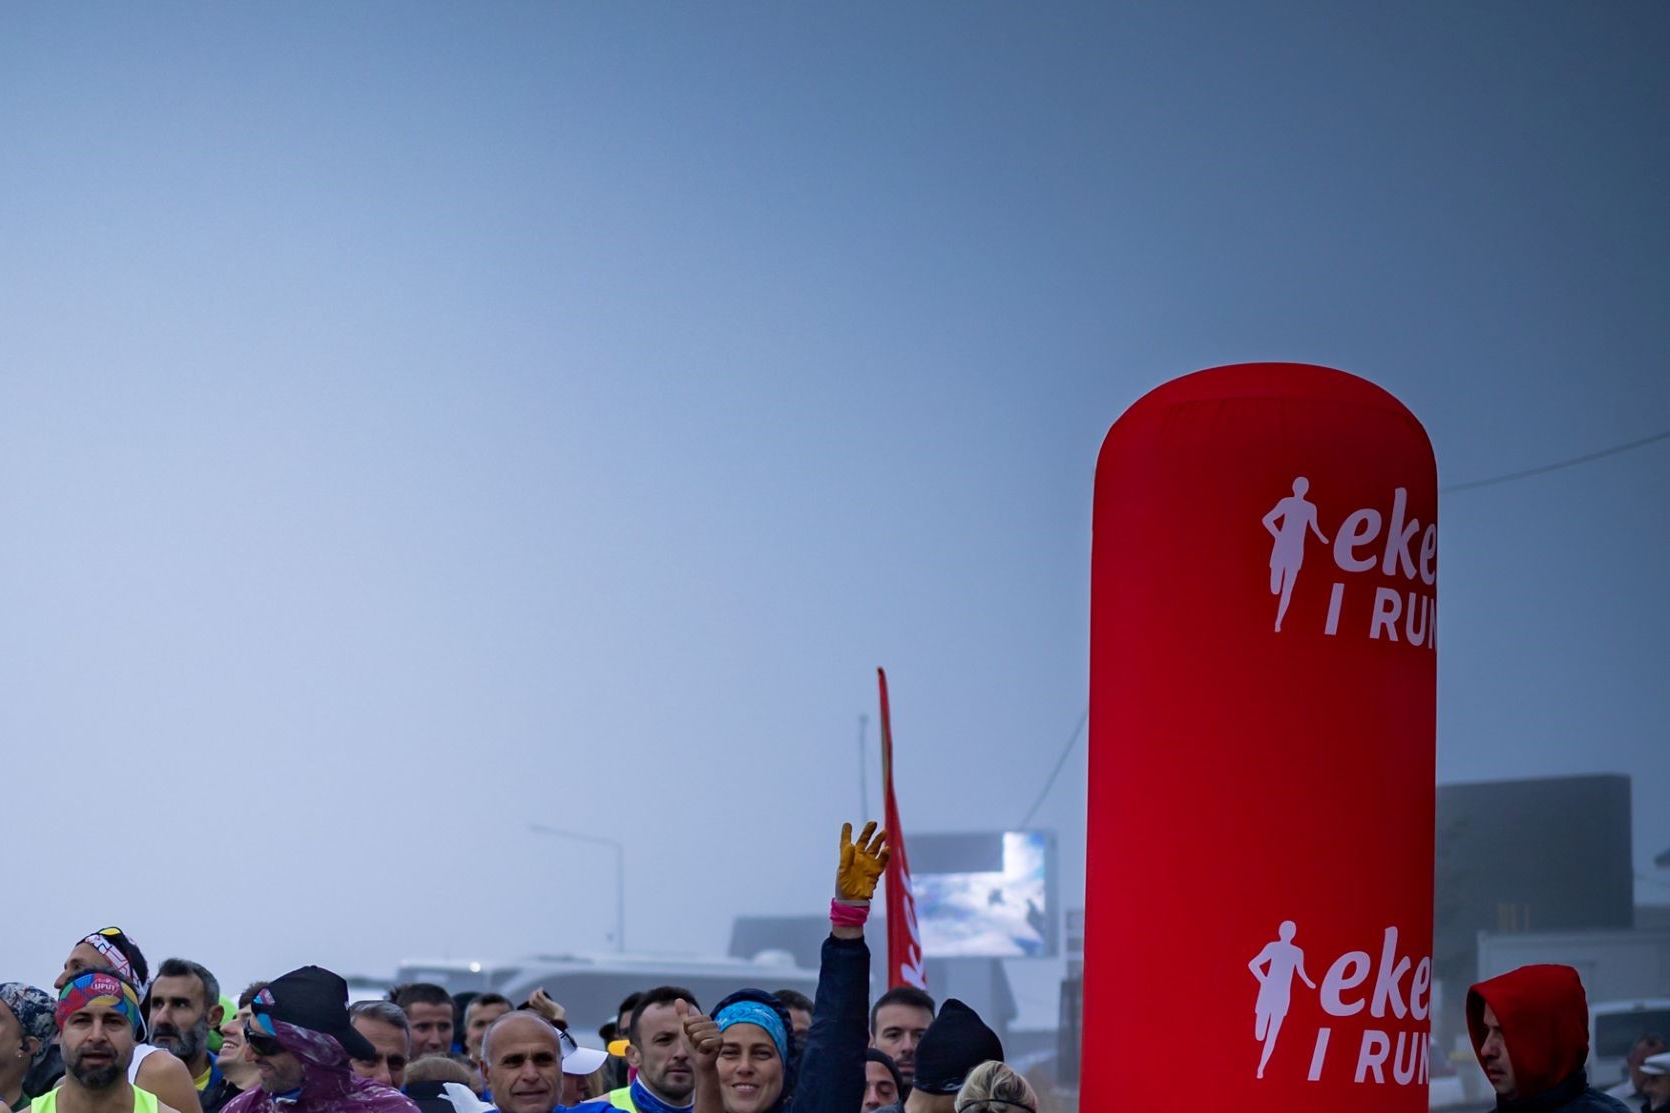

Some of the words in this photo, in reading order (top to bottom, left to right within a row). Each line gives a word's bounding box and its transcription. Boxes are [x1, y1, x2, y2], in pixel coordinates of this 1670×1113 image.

[1333, 487, 1437, 585] eke
[1324, 583, 1344, 635] I
[1320, 926, 1432, 1021] eke
[1307, 1027, 1330, 1081] I
